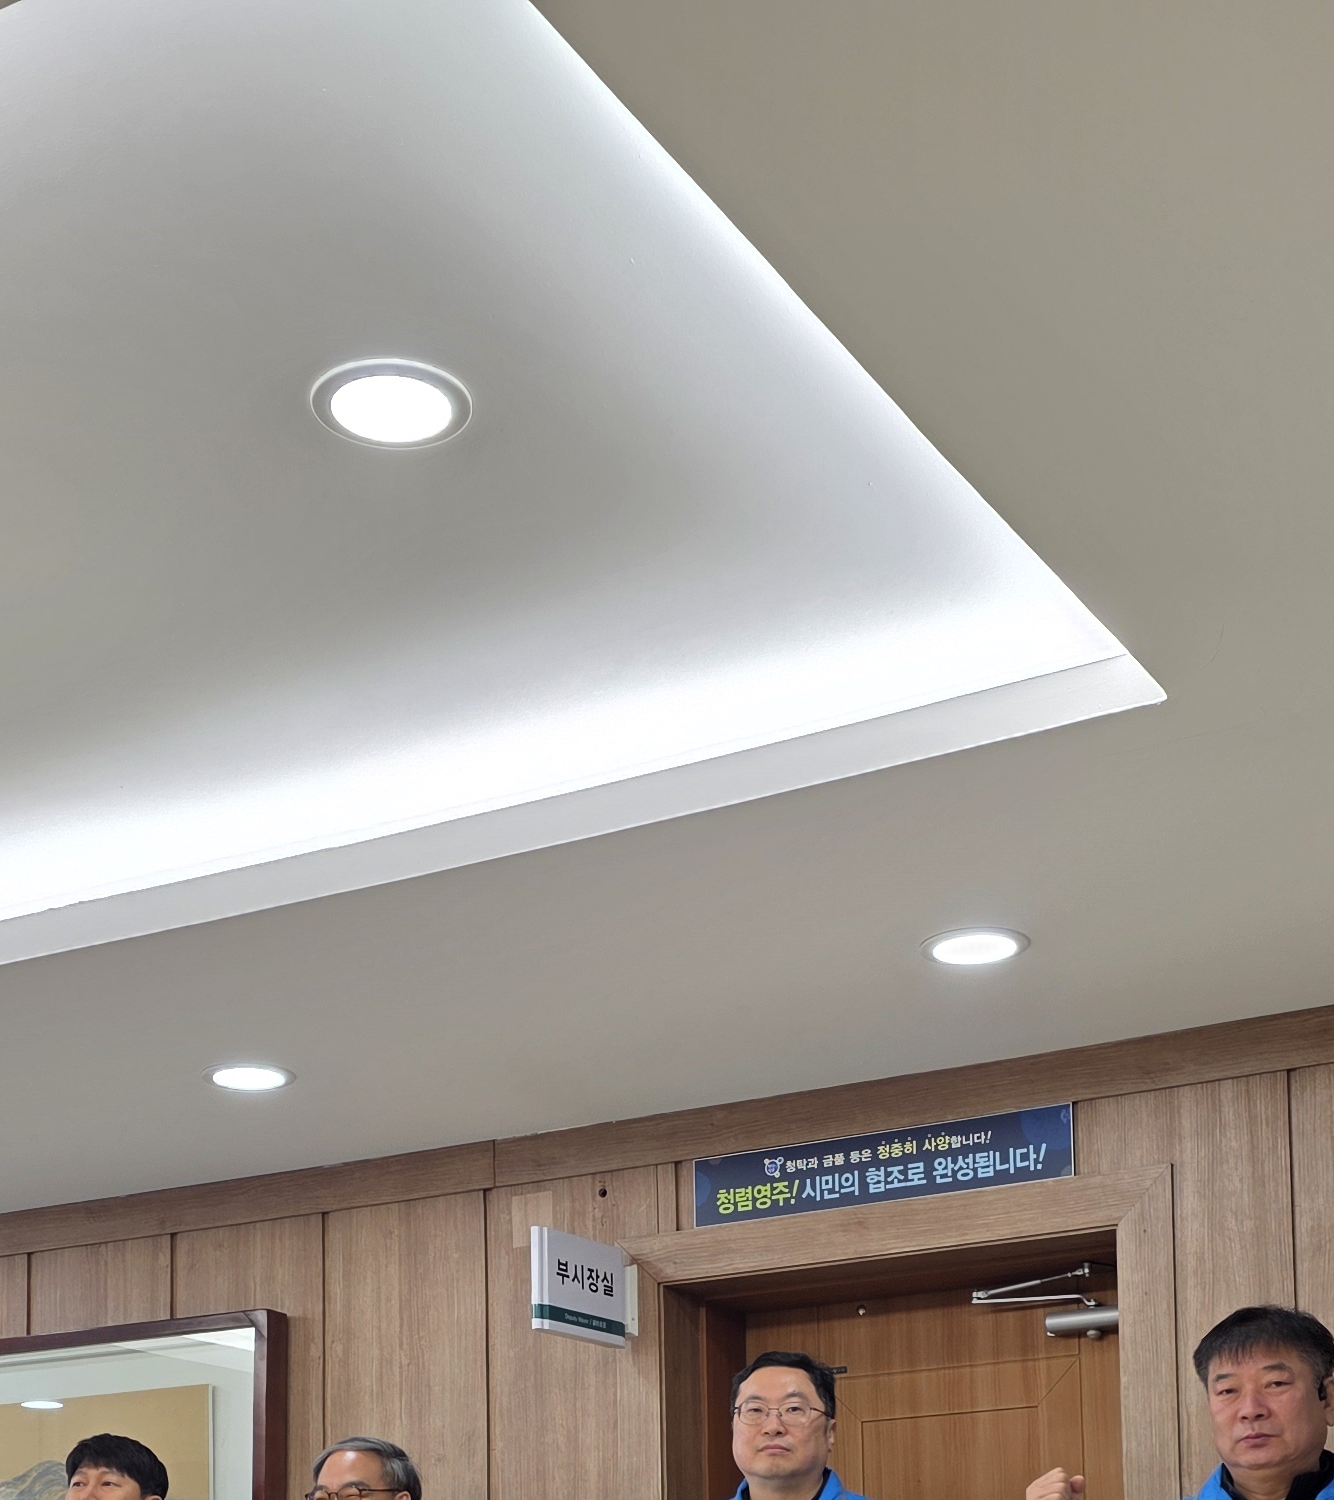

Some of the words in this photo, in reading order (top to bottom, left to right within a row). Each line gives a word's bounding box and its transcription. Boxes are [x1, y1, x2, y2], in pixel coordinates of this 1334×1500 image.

[785, 1156, 819, 1175] 청탁과
[822, 1152, 845, 1169] 금품
[849, 1148, 873, 1164] 등은
[876, 1137, 917, 1160] 정중히
[921, 1131, 992, 1154] 사양합니다!
[715, 1178, 799, 1214] 청렴영주!
[801, 1169, 860, 1201] 시민의
[865, 1160, 928, 1194] 협조로
[932, 1142, 1046, 1185] 완성됩니다!
[556, 1258, 614, 1297] 부시장실
